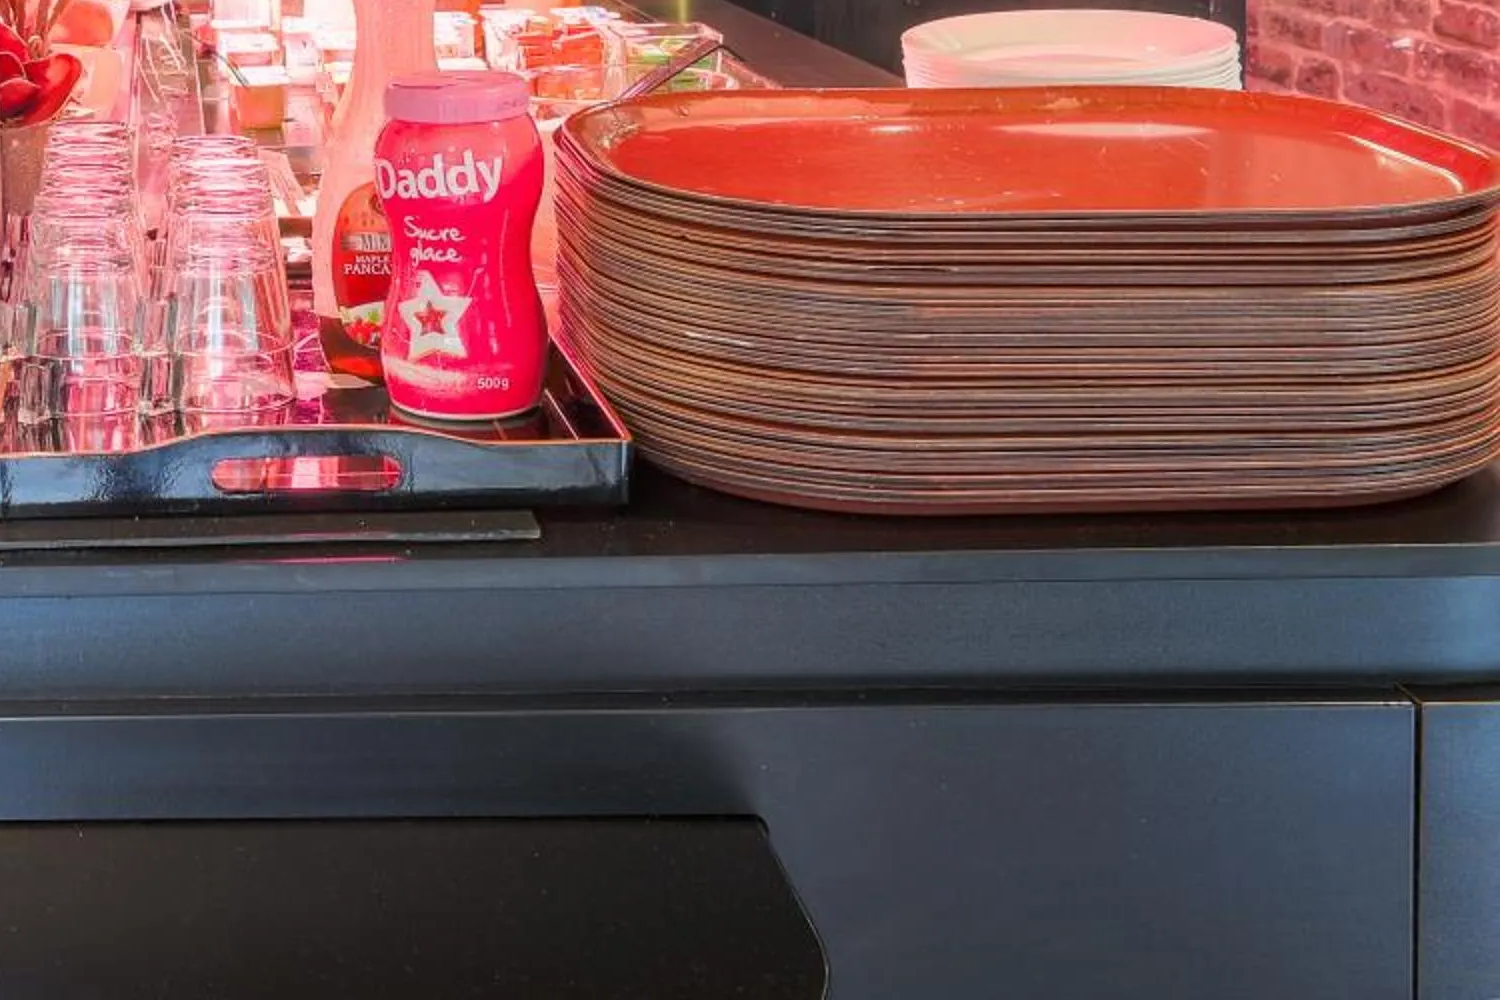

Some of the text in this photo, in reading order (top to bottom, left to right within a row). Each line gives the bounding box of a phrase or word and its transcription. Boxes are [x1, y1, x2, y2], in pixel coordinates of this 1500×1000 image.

[375, 149, 504, 203] Daddy
[403, 215, 466, 242] Sucre
[409, 240, 463, 268] glace
[343, 264, 392, 275] PANCA
[477, 376, 510, 391] 500g
